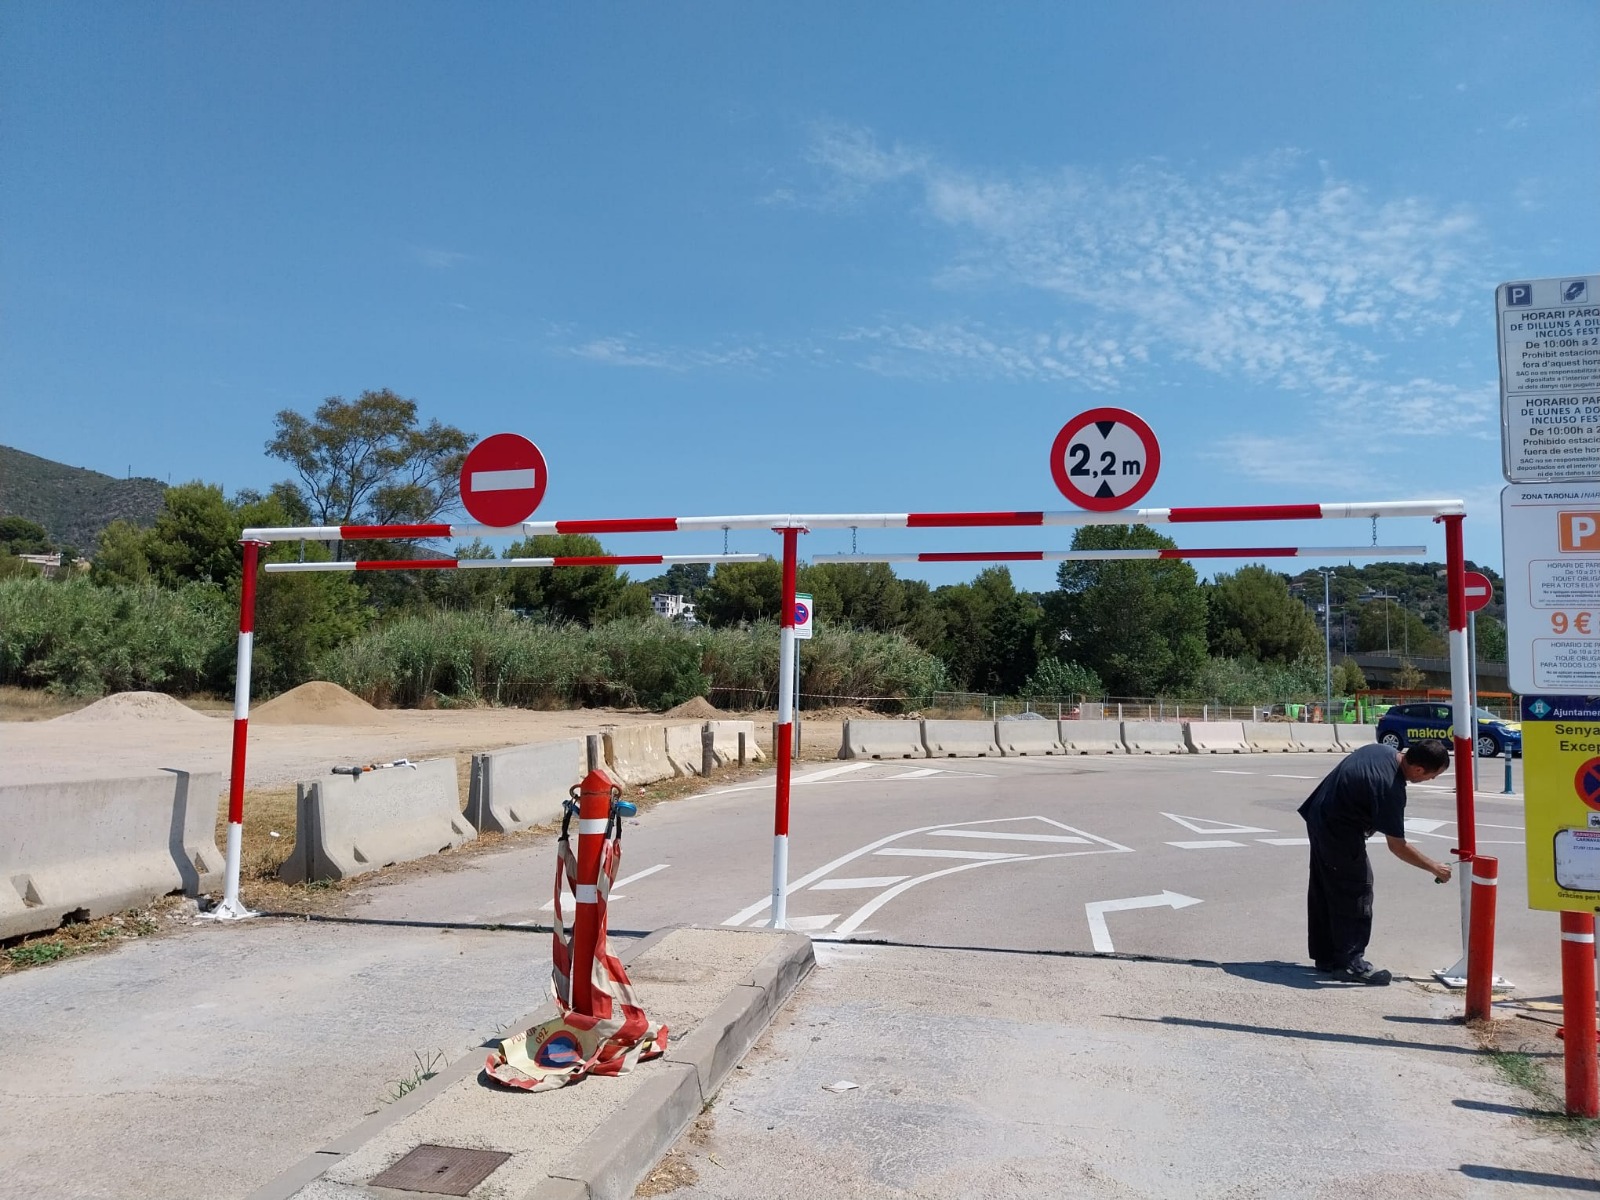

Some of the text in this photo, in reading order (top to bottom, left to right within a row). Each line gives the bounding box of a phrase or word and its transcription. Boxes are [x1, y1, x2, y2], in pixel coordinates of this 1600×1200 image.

[1512, 288, 1524, 304] P
[1522, 311, 1565, 320] HORARI
[1528, 320, 1570, 330] DILLUNS
[1544, 339, 1578, 348] 10:00h
[1522, 350, 1558, 359] Prohibit
[1542, 359, 1580, 369] d'aquest
[1526, 398, 1578, 407] HORARIO
[1538, 407, 1570, 416] LUNES
[1532, 416, 1576, 424] INCLUSO
[1530, 428, 1544, 436] De
[1548, 426, 1583, 435] 10:00h
[1524, 438, 1566, 446] Prohibido
[1069, 443, 1140, 478] 2,2 m
[1572, 516, 1596, 547] P
[1408, 728, 1446, 738] makro
[1555, 724, 1600, 738] Senya
